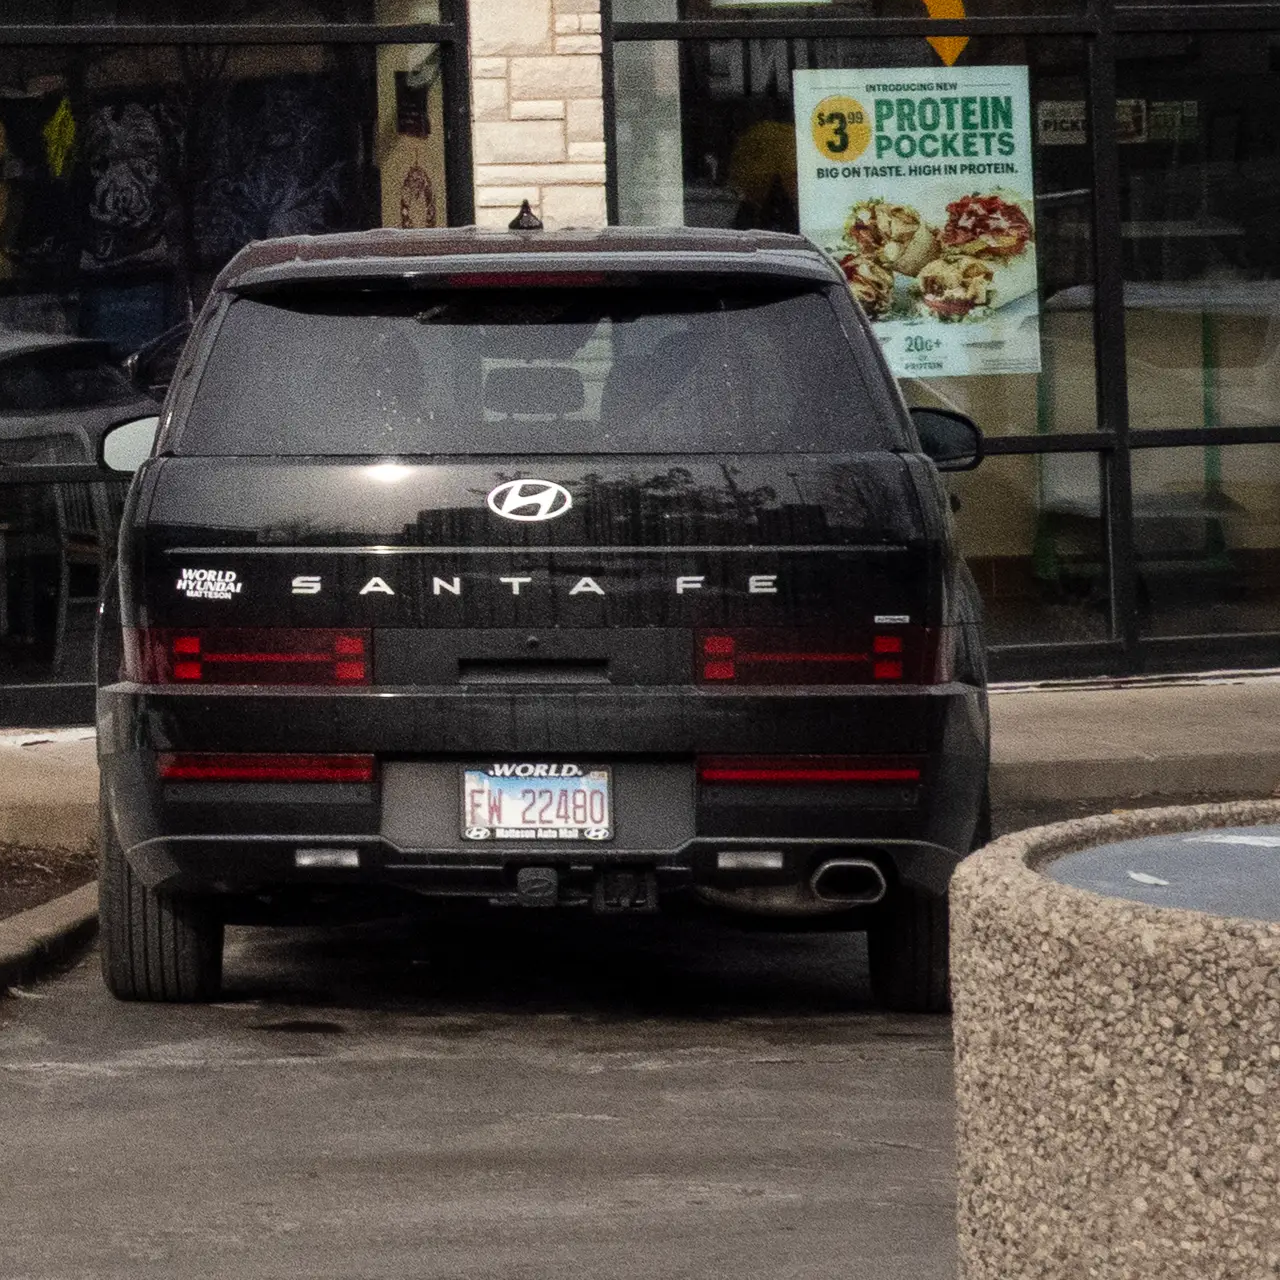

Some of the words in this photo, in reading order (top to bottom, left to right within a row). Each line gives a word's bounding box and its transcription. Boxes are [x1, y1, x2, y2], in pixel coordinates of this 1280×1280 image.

[865, 83, 934, 93] INTRODUCING
[935, 82, 958, 92] NEW
[874, 96, 1013, 132] PROTEIN
[875, 132, 1015, 159] POCKETS
[816, 167, 839, 178] BIG
[841, 167, 862, 178] ON
[863, 165, 906, 177] TASTE.
[909, 164, 941, 176] HIGH
[944, 164, 957, 175] IN
[960, 163, 1018, 175] PROTEIN.
[182, 568, 236, 582] WORLD
[176, 579, 242, 593] HYUNDAI
[291, 575, 606, 596] SANTA
[676, 575, 778, 595] FE
[186, 590, 232, 600] MATTESON
[470, 789, 503, 824] FW
[521, 789, 605, 824] 22480
[537, 828, 558, 838] Auto
